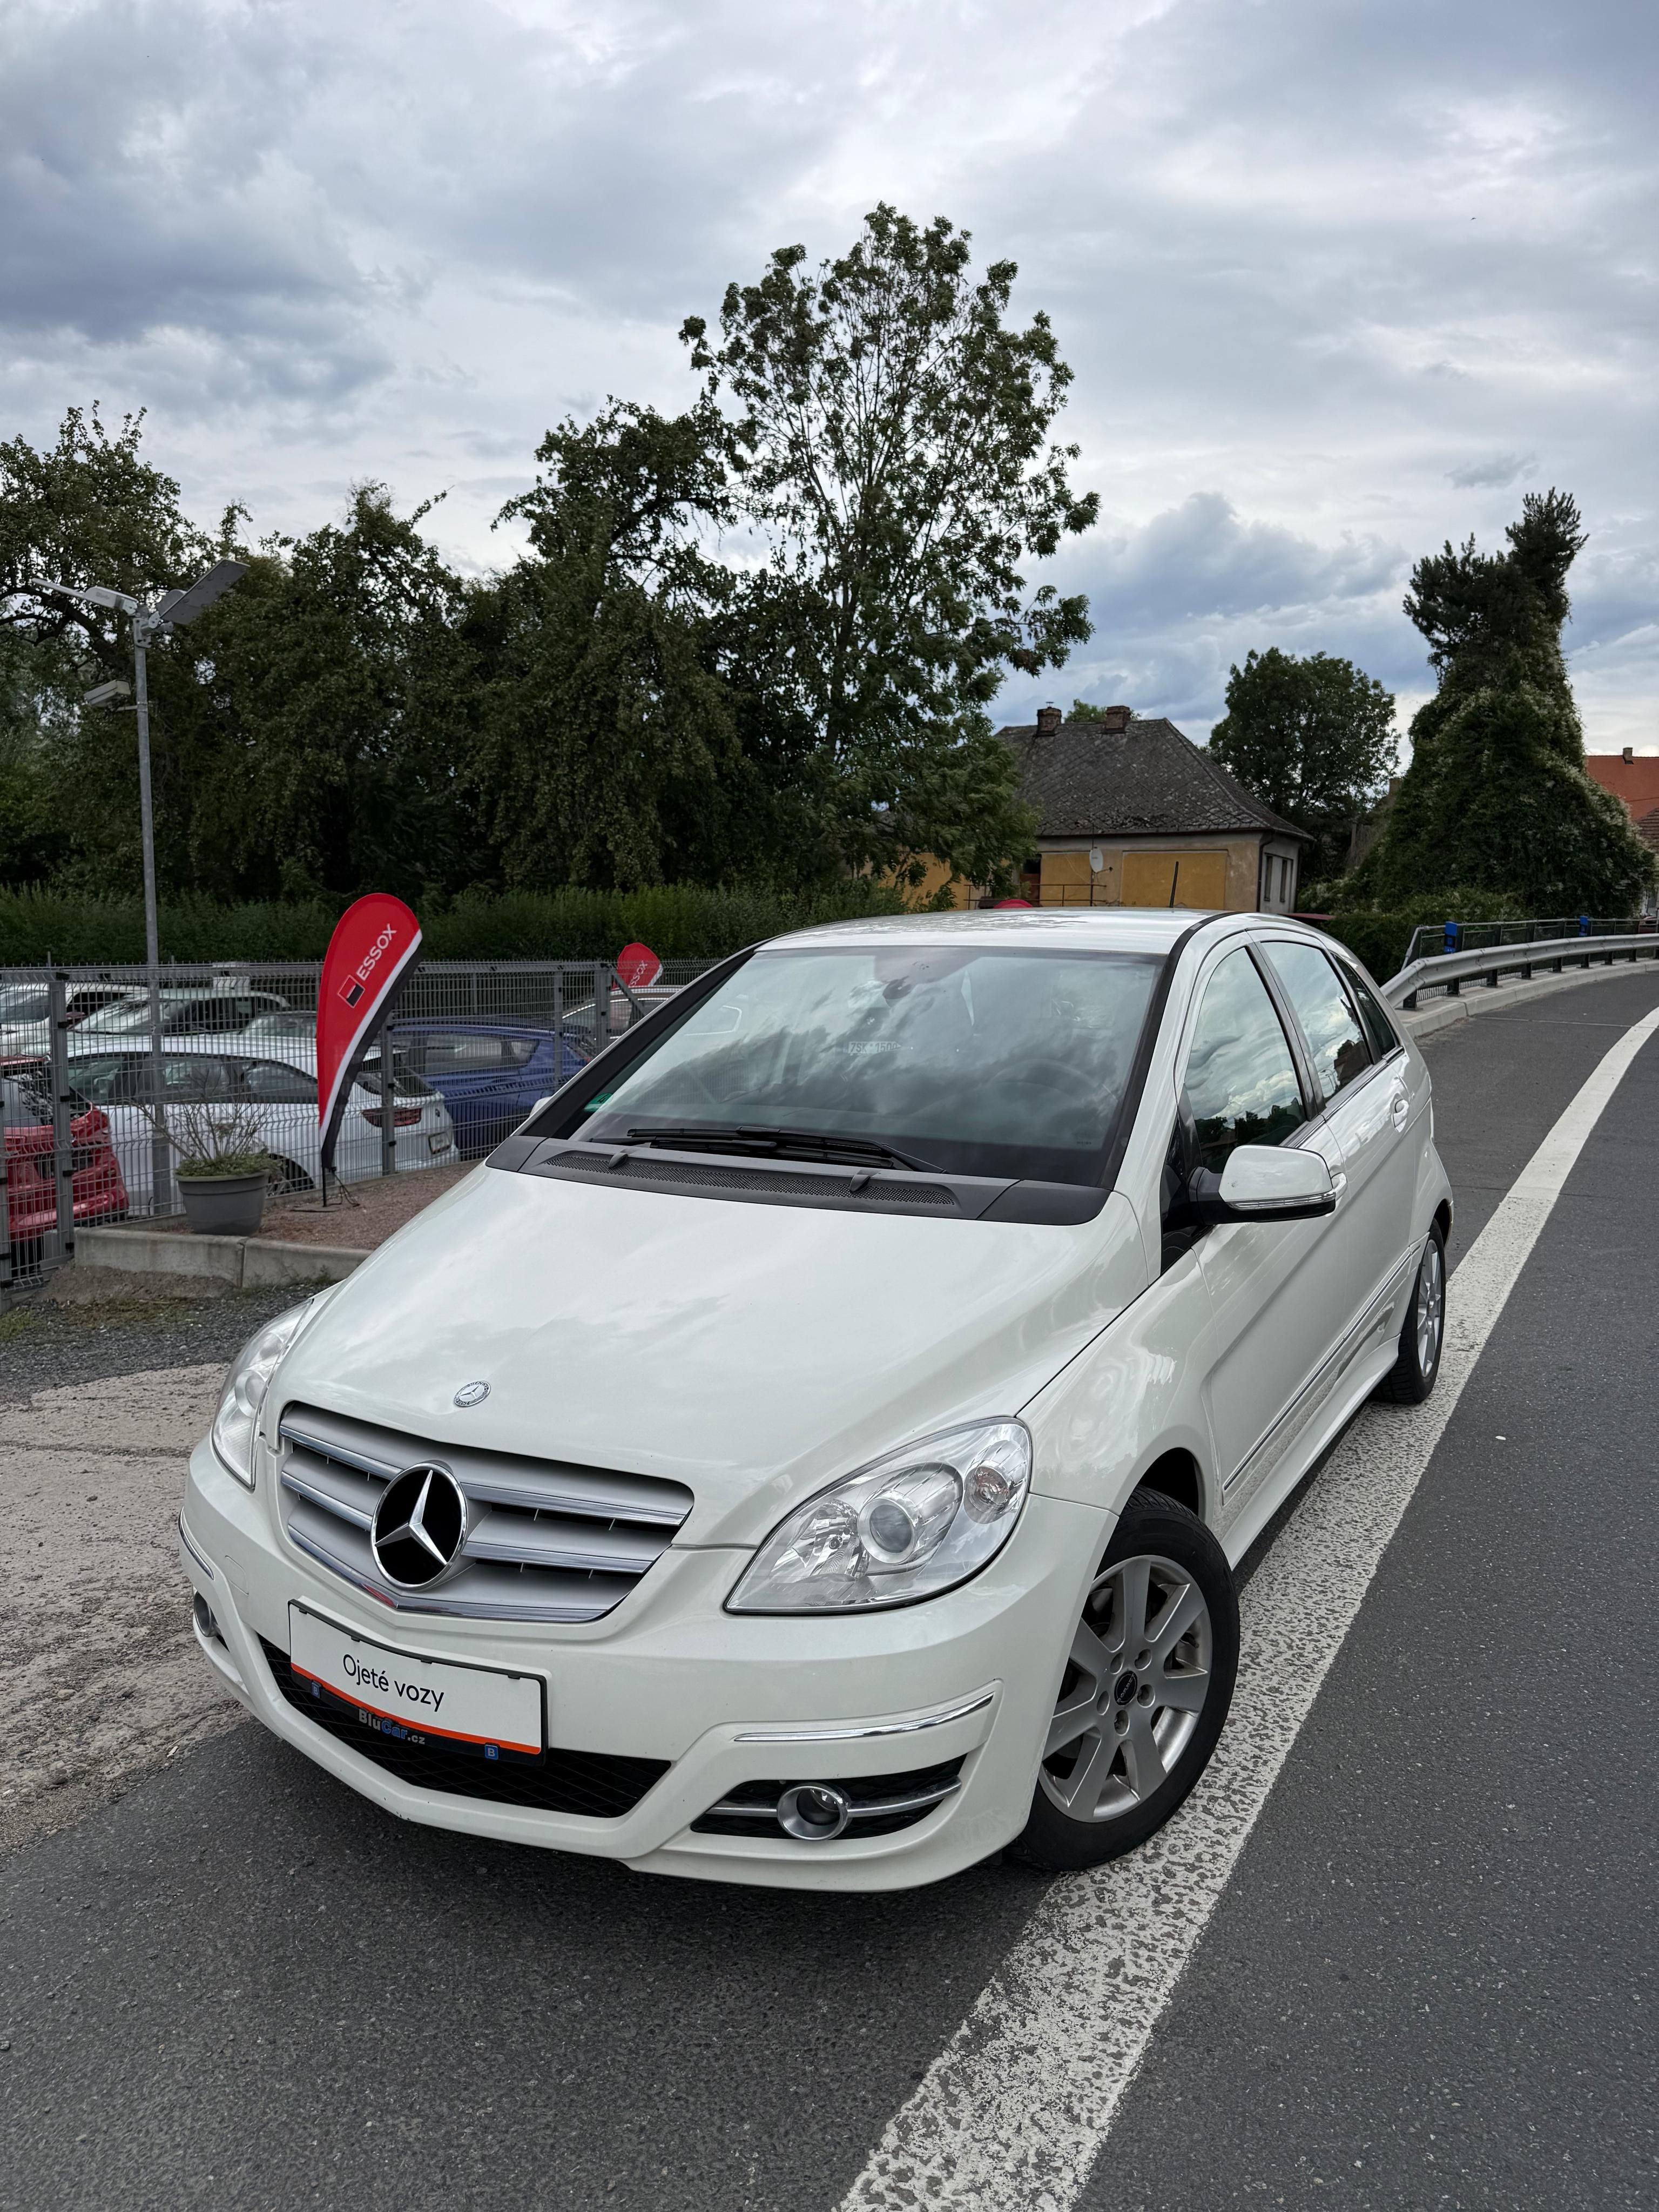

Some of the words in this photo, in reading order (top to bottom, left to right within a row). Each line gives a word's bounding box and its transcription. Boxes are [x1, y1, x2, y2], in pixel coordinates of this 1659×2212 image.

[356, 923, 397, 981] ESSOX
[628, 960, 648, 988] SSOX
[850, 1042, 867, 1053] 7SK
[343, 1654, 389, 1692] Ojeté
[394, 1680, 444, 1712] vozy
[359, 1708, 425, 1745] BluCar.cz
[488, 1748, 495, 1757] B
